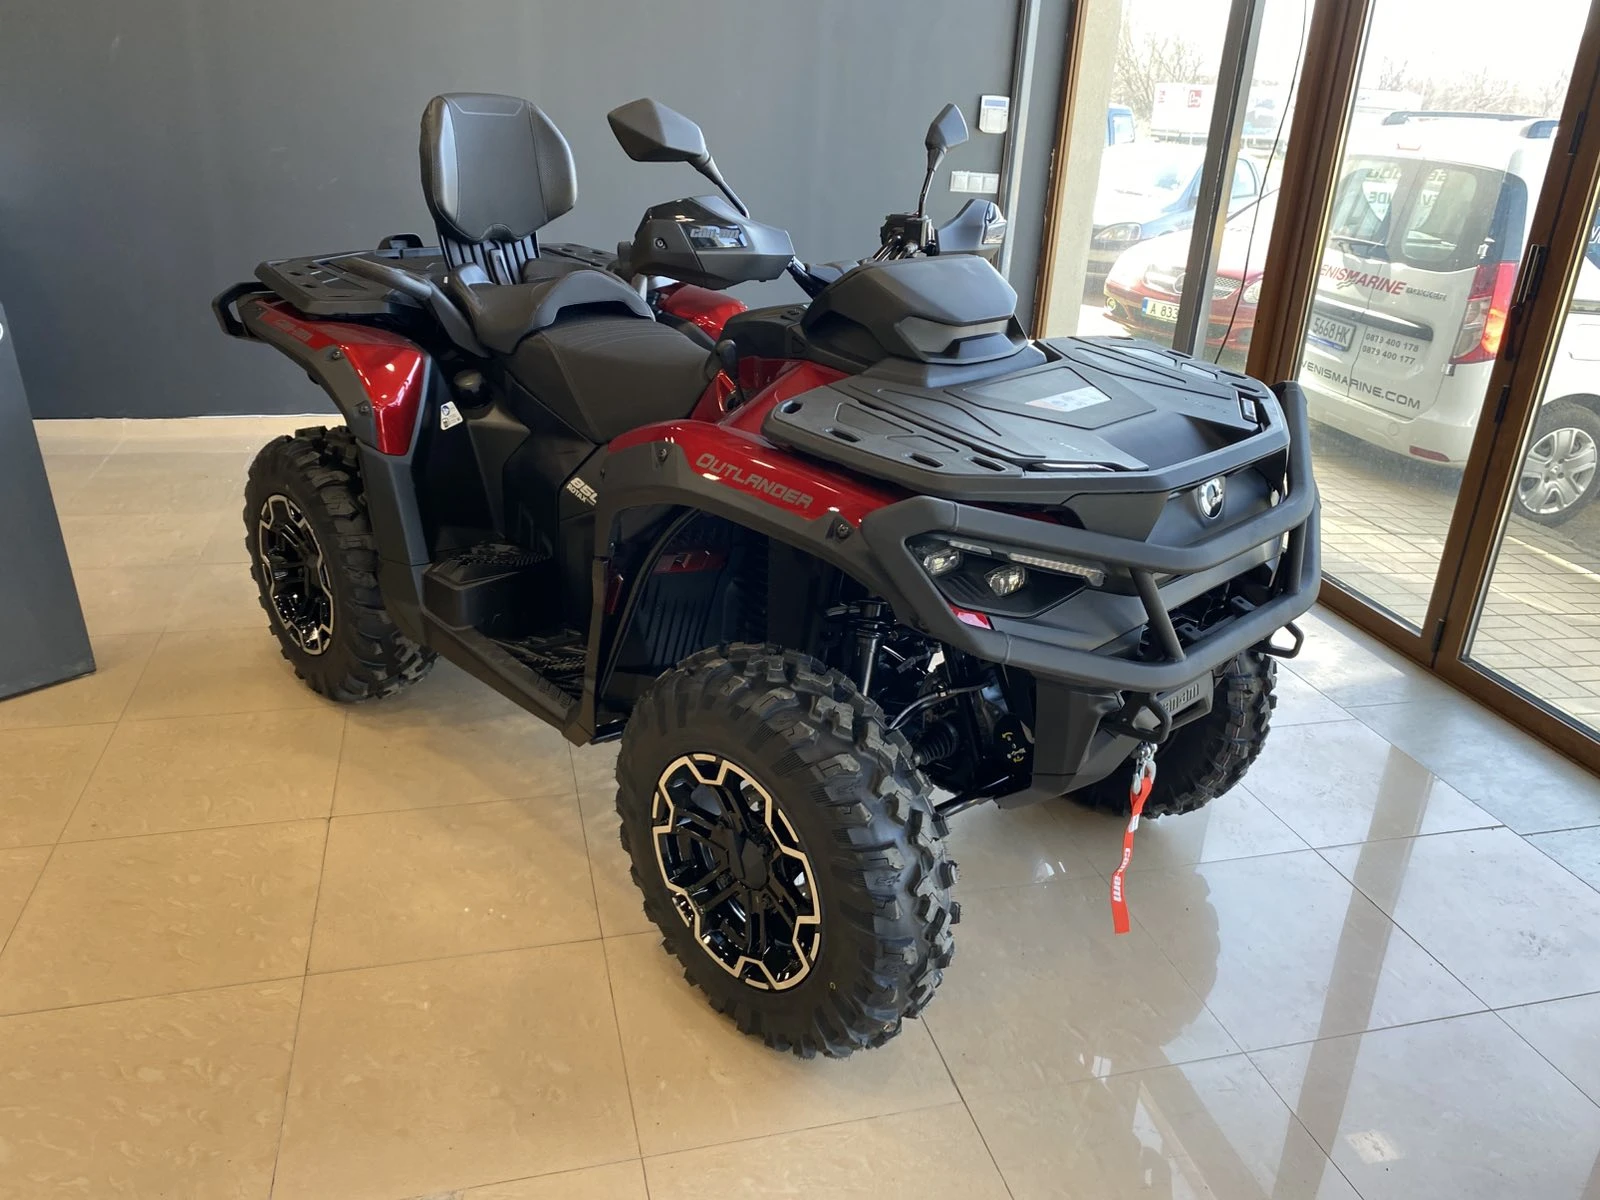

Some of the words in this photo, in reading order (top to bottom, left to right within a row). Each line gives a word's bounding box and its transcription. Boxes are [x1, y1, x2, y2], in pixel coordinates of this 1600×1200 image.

[1319, 264, 1407, 296] ENISMARINE
[1386, 338, 1401, 348] 400
[1382, 350, 1397, 360] 400
[1400, 355, 1416, 365] 177
[695, 452, 814, 509] OUTLANDER
